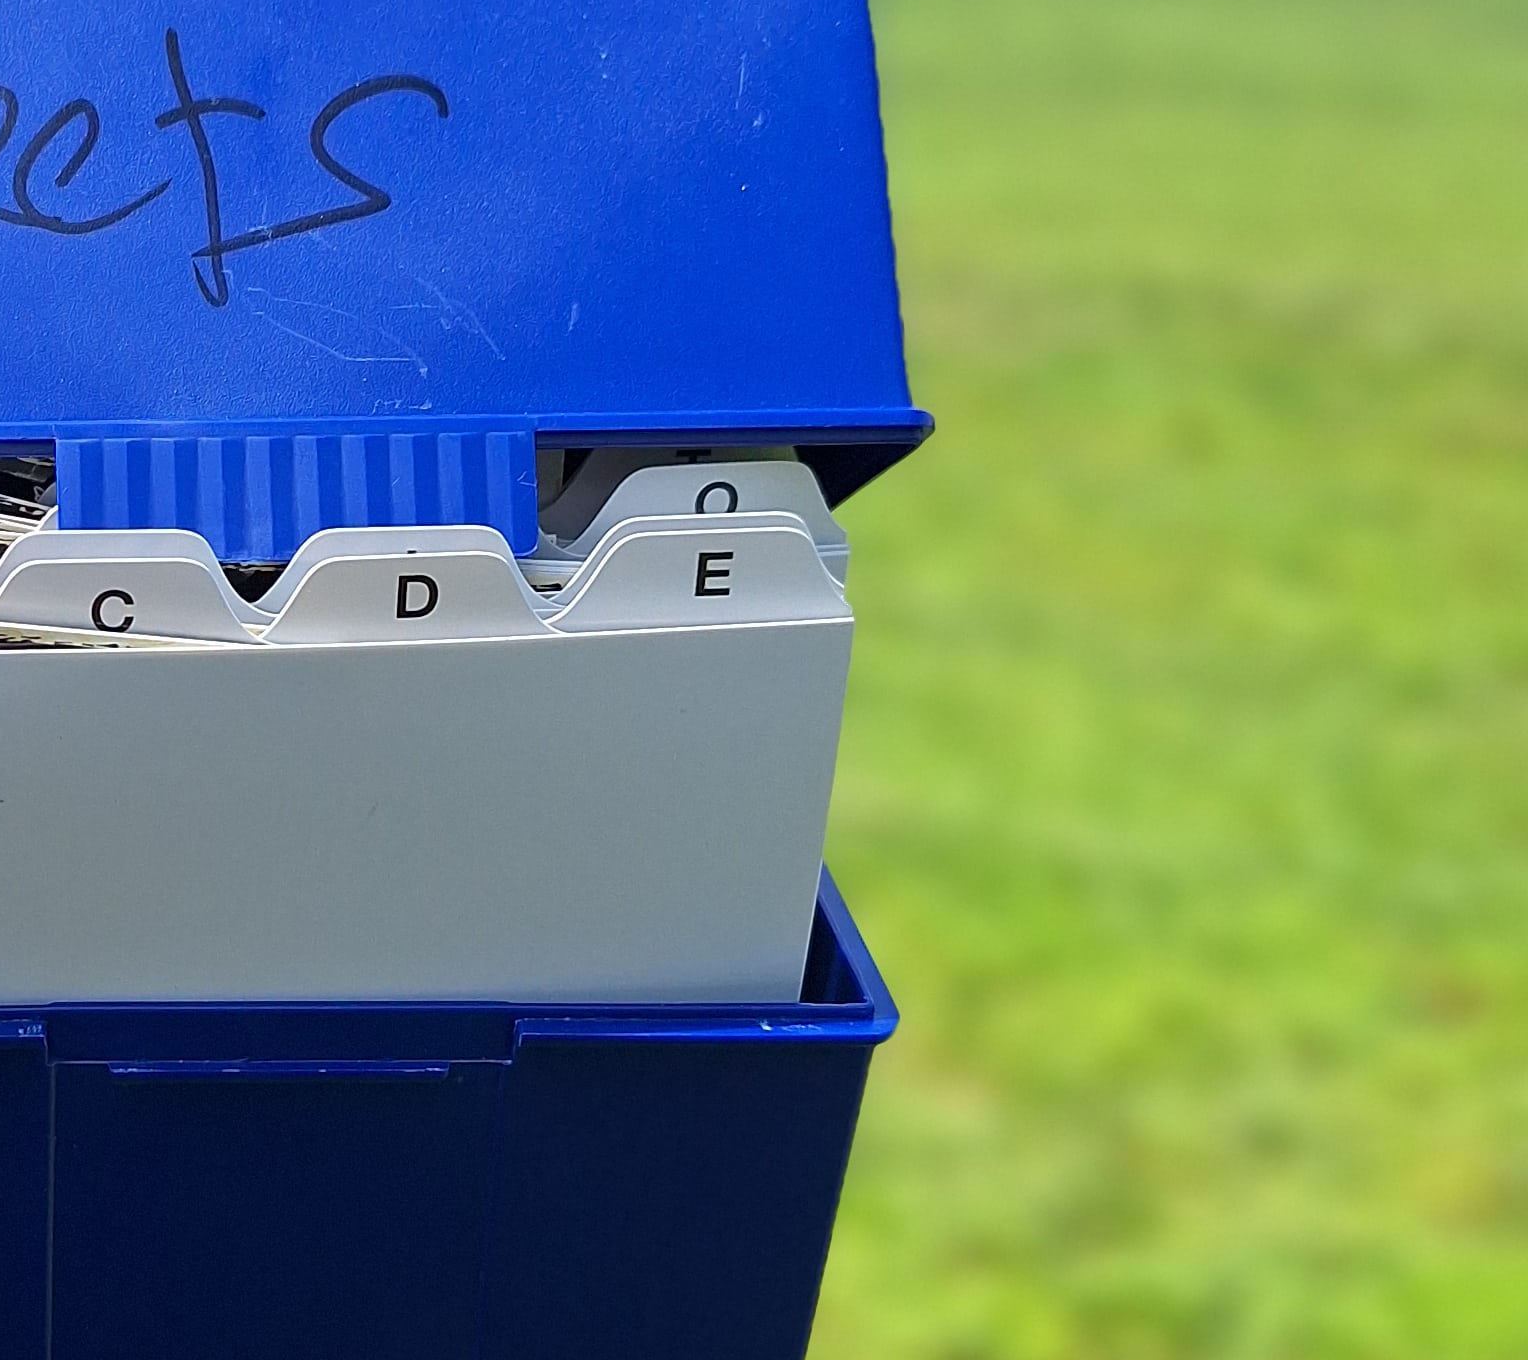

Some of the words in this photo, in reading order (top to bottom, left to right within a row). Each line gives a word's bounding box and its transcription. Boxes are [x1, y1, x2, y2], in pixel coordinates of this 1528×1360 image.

[396, 573, 440, 620] D
[694, 551, 735, 597] E
[90, 588, 135, 633] C
